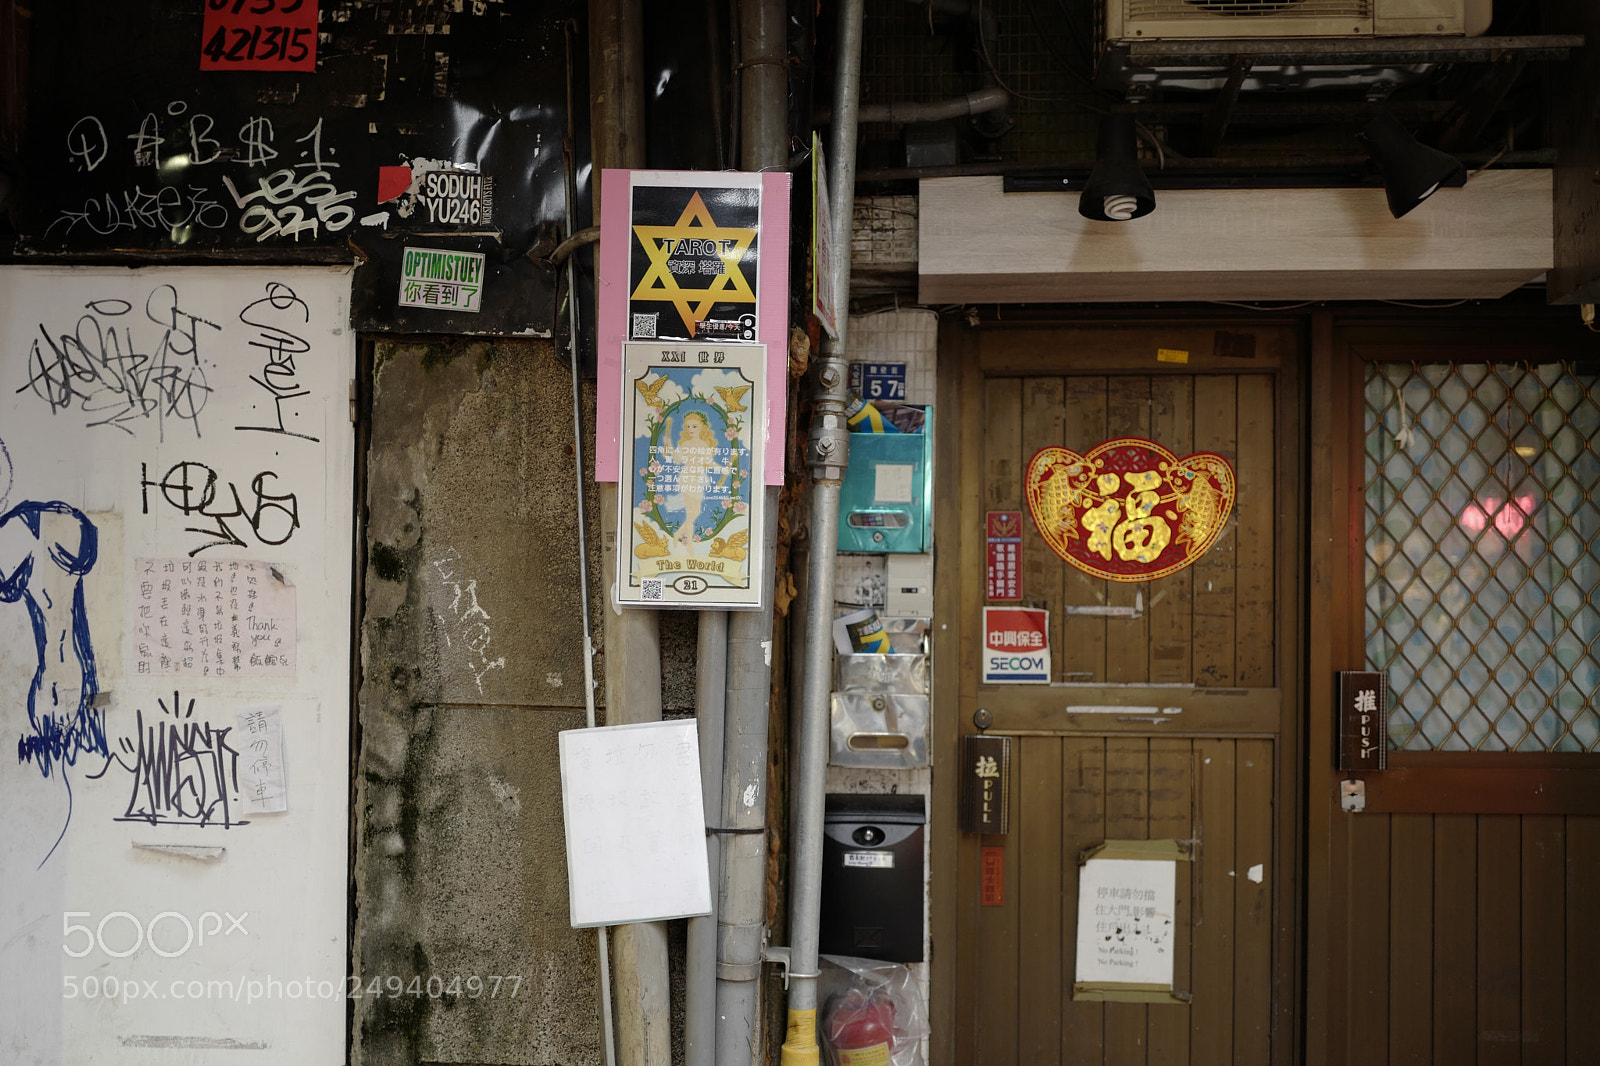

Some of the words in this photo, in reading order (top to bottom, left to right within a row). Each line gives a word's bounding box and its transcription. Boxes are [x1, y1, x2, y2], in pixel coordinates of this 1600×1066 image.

[203, 25, 312, 62] 421315
[426, 173, 482, 199] SODUH
[426, 198, 481, 224] YU246
[662, 238, 732, 257] TAROT
[404, 250, 482, 284] OPTIMISTUEY
[667, 260, 696, 275] 資深
[699, 260, 726, 275] 塔羅
[403, 281, 479, 308] 你看到了
[698, 352, 725, 363] 世界
[870, 379, 899, 398] 57
[1081, 470, 1172, 563] 福
[655, 560, 682, 572] The
[686, 559, 726, 572] World
[683, 580, 698, 590] 21
[246, 616, 279, 632] Thank
[989, 630, 1044, 648] 中興保全
[990, 657, 1044, 671] SECOM
[1354, 690, 1377, 712] 推
[1360, 714, 1372, 759] PUSH
[244, 710, 274, 810] 請勿停車
[975, 755, 999, 778] 拉
[983, 779, 993, 823] PULL
